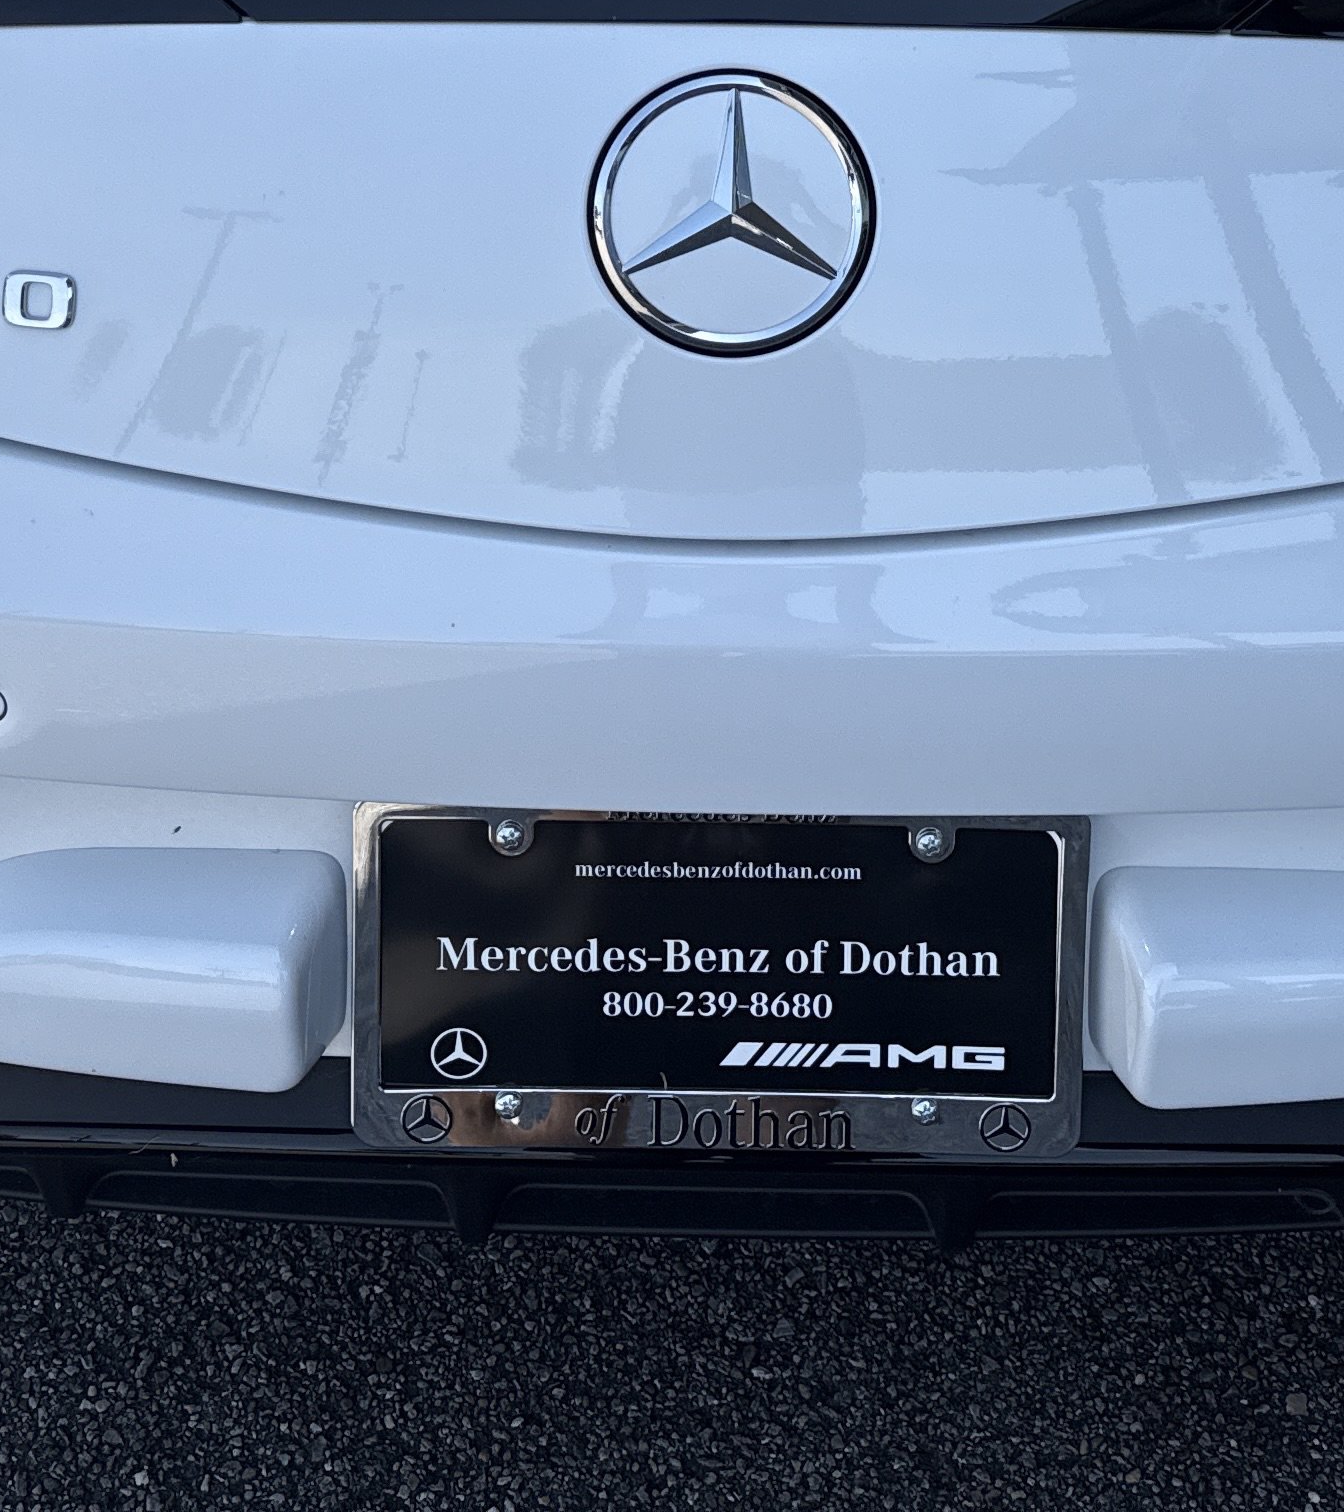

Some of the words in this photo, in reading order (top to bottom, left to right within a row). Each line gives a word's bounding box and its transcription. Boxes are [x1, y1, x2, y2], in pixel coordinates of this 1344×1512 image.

[575, 861, 862, 880] mercedesbenzofdothan.com
[435, 936, 770, 974] Mercedes-Benz
[785, 939, 830, 974] of
[839, 941, 1001, 977] Dothan
[602, 991, 834, 1019] 800-239-8680
[819, 1043, 1006, 1071] AMG
[575, 1093, 629, 1146] of
[647, 1094, 857, 1151] Dothan
